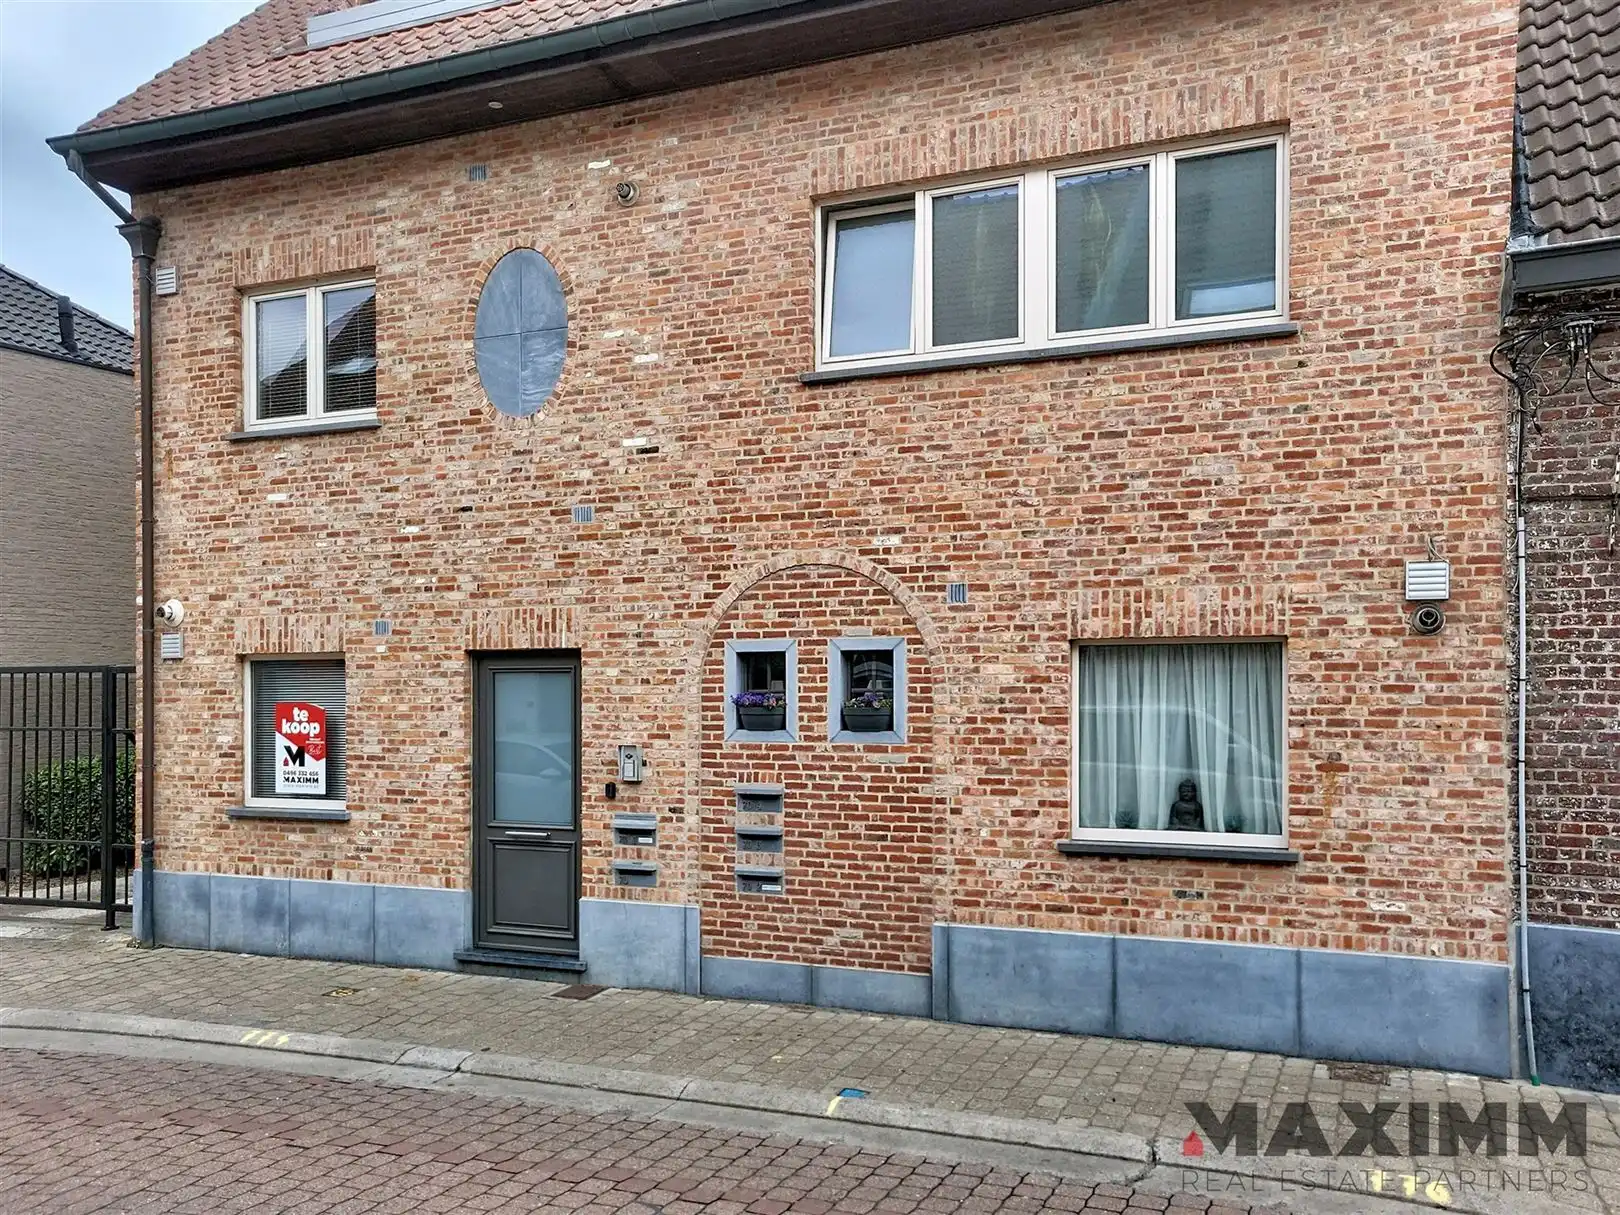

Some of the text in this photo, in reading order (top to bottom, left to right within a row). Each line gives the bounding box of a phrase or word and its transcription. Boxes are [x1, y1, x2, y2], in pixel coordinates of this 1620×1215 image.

[293, 707, 309, 722] te
[281, 718, 320, 737] koop
[283, 776, 319, 784] MAXIMM
